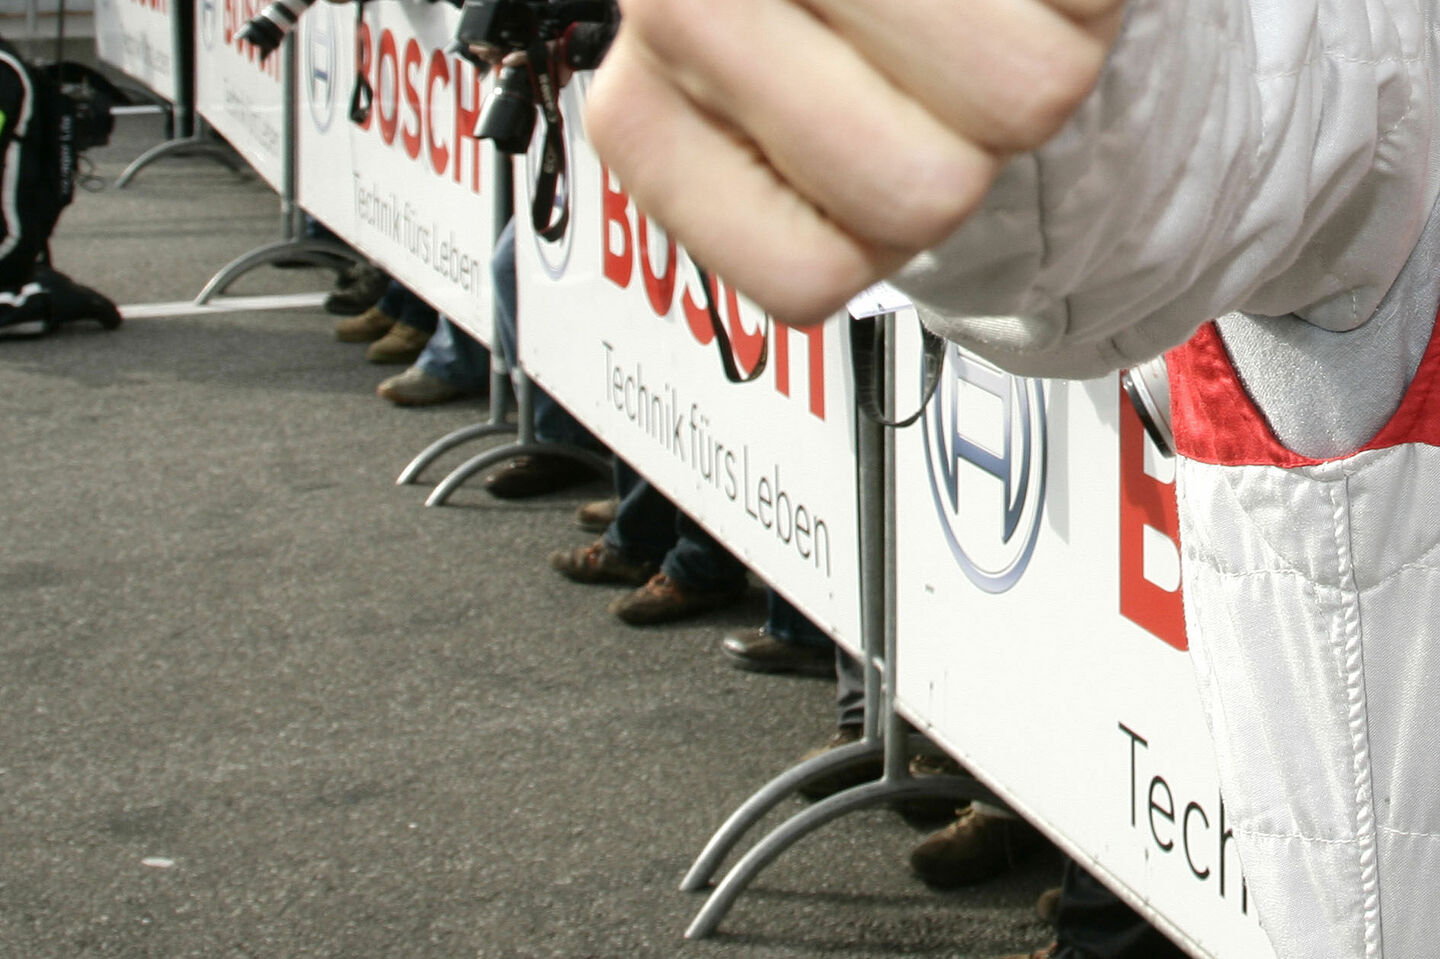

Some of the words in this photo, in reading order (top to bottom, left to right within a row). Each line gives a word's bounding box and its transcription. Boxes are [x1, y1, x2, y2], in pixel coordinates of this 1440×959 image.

[355, 21, 481, 195] BOSCH
[353, 170, 400, 245] Technik
[432, 222, 480, 299] Leben
[602, 339, 686, 462] Technik
[688, 402, 738, 501] fürs
[743, 444, 832, 578] Leben
